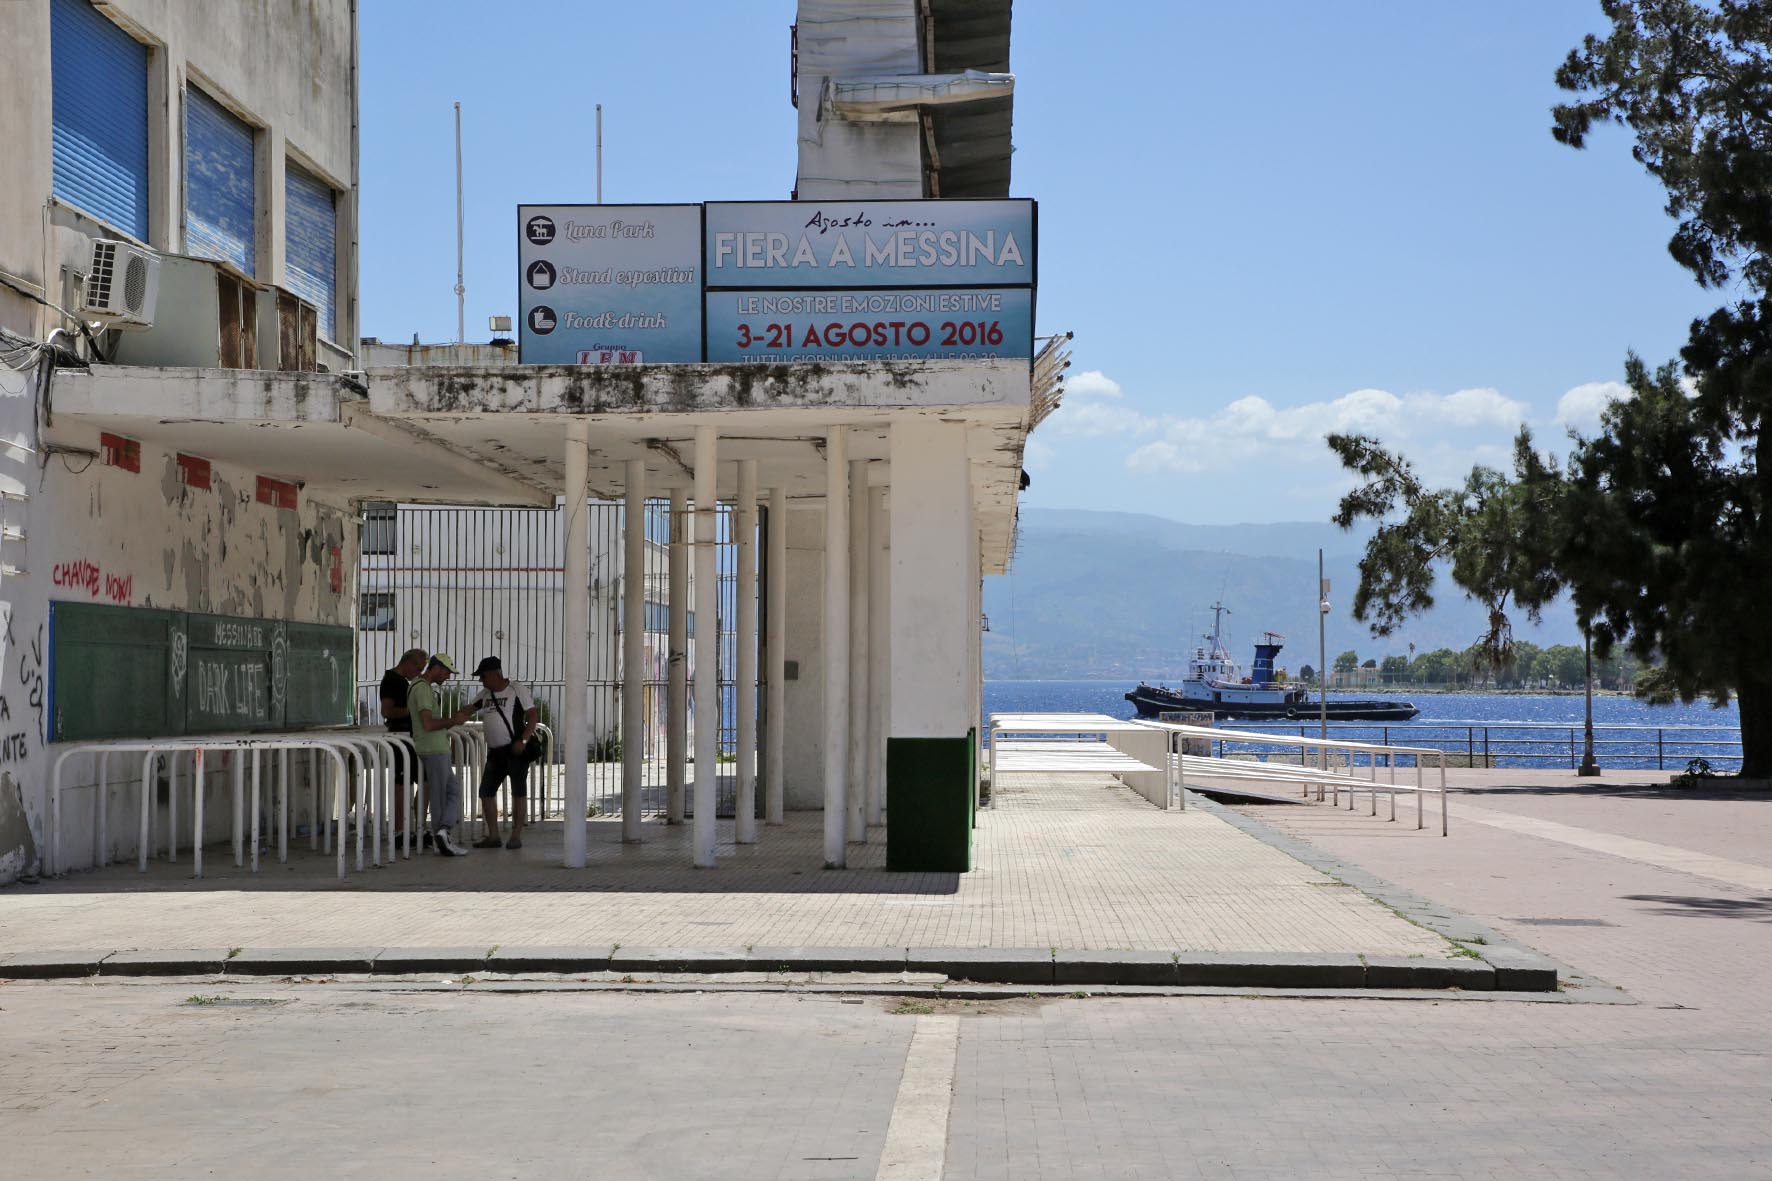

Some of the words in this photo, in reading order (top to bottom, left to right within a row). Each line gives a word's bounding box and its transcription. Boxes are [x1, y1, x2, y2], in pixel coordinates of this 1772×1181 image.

[564, 220, 606, 243] Luna
[609, 219, 655, 239] Park
[805, 210, 872, 234] Agosto
[714, 231, 818, 269] FIERA
[828, 231, 857, 268] A
[863, 229, 1025, 269] MESSINA
[560, 266, 612, 285] Stand
[616, 266, 695, 289] espositivi
[737, 296, 759, 315] LE
[763, 295, 837, 315] NOSTRE
[841, 294, 936, 314] EMOZIONI
[938, 293, 1001, 313] ESTIVE
[563, 311, 667, 330] Food&drink
[736, 322, 793, 349] 3-21
[801, 321, 931, 348] AGOSTO
[940, 320, 1004, 347] 2016
[593, 343, 627, 352] Gruppo
[199, 661, 230, 714] DARK
[0, 732, 28, 763] NTE
